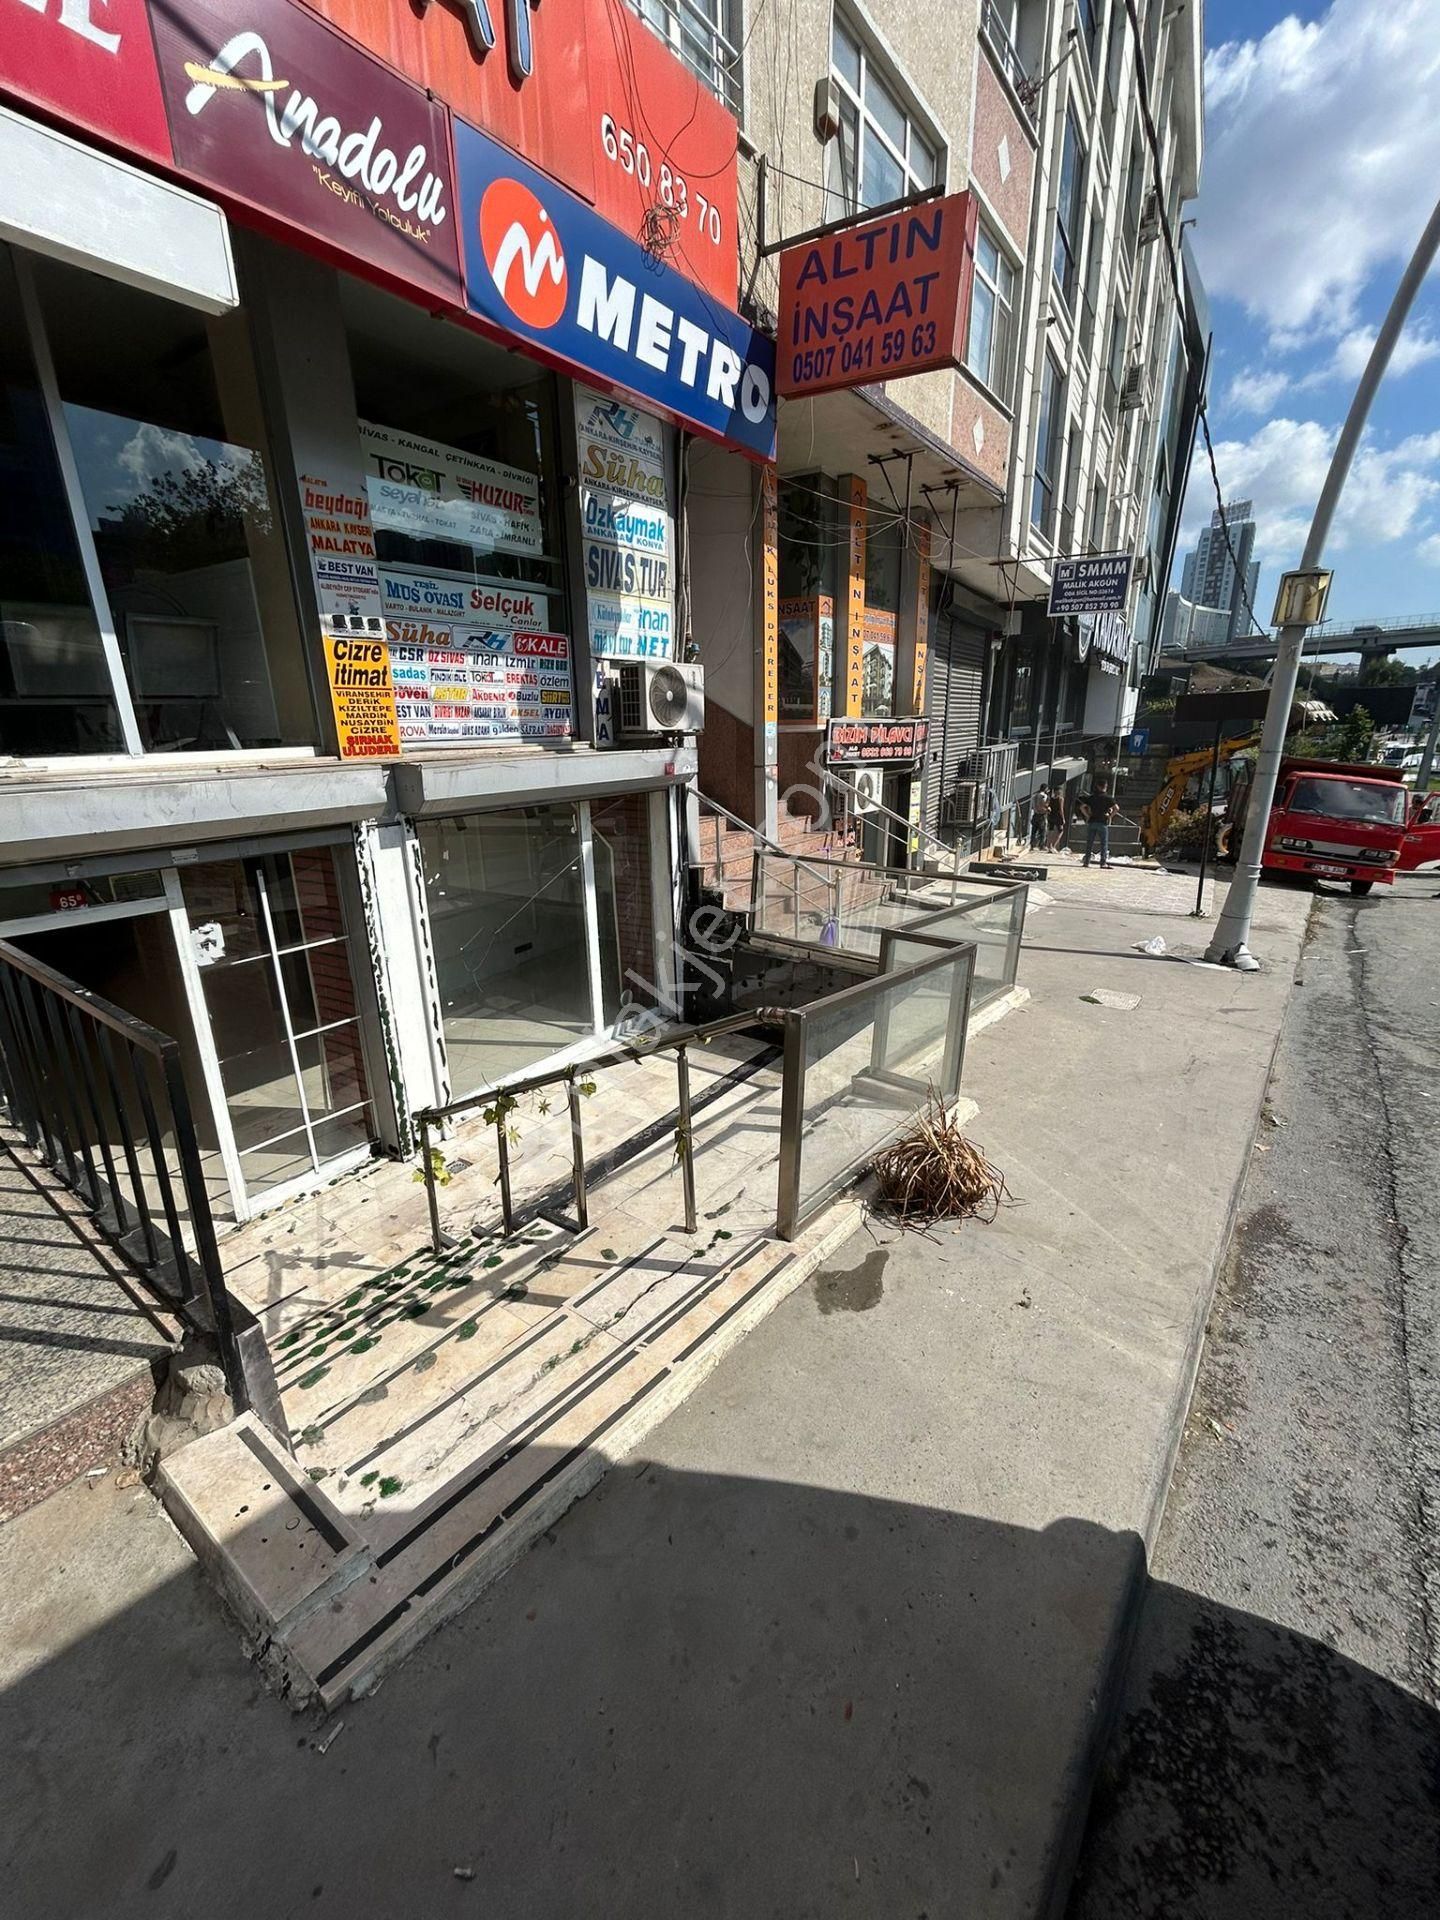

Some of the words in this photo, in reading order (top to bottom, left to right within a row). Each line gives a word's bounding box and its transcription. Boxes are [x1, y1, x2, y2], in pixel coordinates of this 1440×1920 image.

[184, 31, 446, 225] Anadolu
[600, 112, 651, 188] 650
[659, 163, 689, 219] 83
[696, 192, 722, 246] 70
[796, 207, 944, 291] ALTIN
[792, 272, 940, 348] İNŞAAT
[577, 253, 771, 424] METRO
[792, 348, 836, 383] 0507
[841, 338, 875, 372] 041
[879, 331, 907, 367] 59
[911, 320, 937, 356] 63
[397, 437, 440, 457] KANGAL
[445, 452, 496, 475] ÇETİNKAYA
[502, 470, 534, 486] DİVRİĞİ
[583, 444, 664, 498] Süha
[471, 480, 525, 515] HUZUR
[471, 510, 498, 525] SİVAS
[586, 492, 665, 543] Özkaymak
[311, 534, 375, 557] MALATYA
[469, 524, 494, 538] ZARA
[499, 531, 536, 547] İMRANLI
[587, 526, 625, 541] ANKARA
[636, 537, 664, 551] KONYA
[327, 560, 353, 574] BEST
[355, 564, 374, 577] VAN
[853, 519, 862, 599] ALTIN
[1078, 561, 1127, 578] SMMM
[640, 556, 668, 599] TUR
[1088, 578, 1118, 588] AKGÜN
[385, 578, 421, 603] MUŞ
[424, 591, 464, 610] OVASI
[469, 588, 534, 618] Selçuk
[1056, 604, 1070, 612] +90
[1070, 603, 1083, 611] 507
[1109, 601, 1119, 609] 90
[386, 620, 451, 646] Süha
[333, 640, 382, 662] Cizre
[399, 646, 424, 662] CSR
[528, 638, 567, 655] KALE
[636, 635, 669, 658] NET
[335, 663, 388, 687] itimat
[540, 676, 569, 688] özlem
[516, 691, 539, 702] Buzlu
[414, 705, 431, 719] VAN
[350, 726, 387, 734] CİZRE
[833, 724, 868, 744] BİZİM
[870, 723, 914, 744] PİLAVCI
[342, 745, 399, 757] ULUDERE
[1158, 787, 1175, 816] JCB
